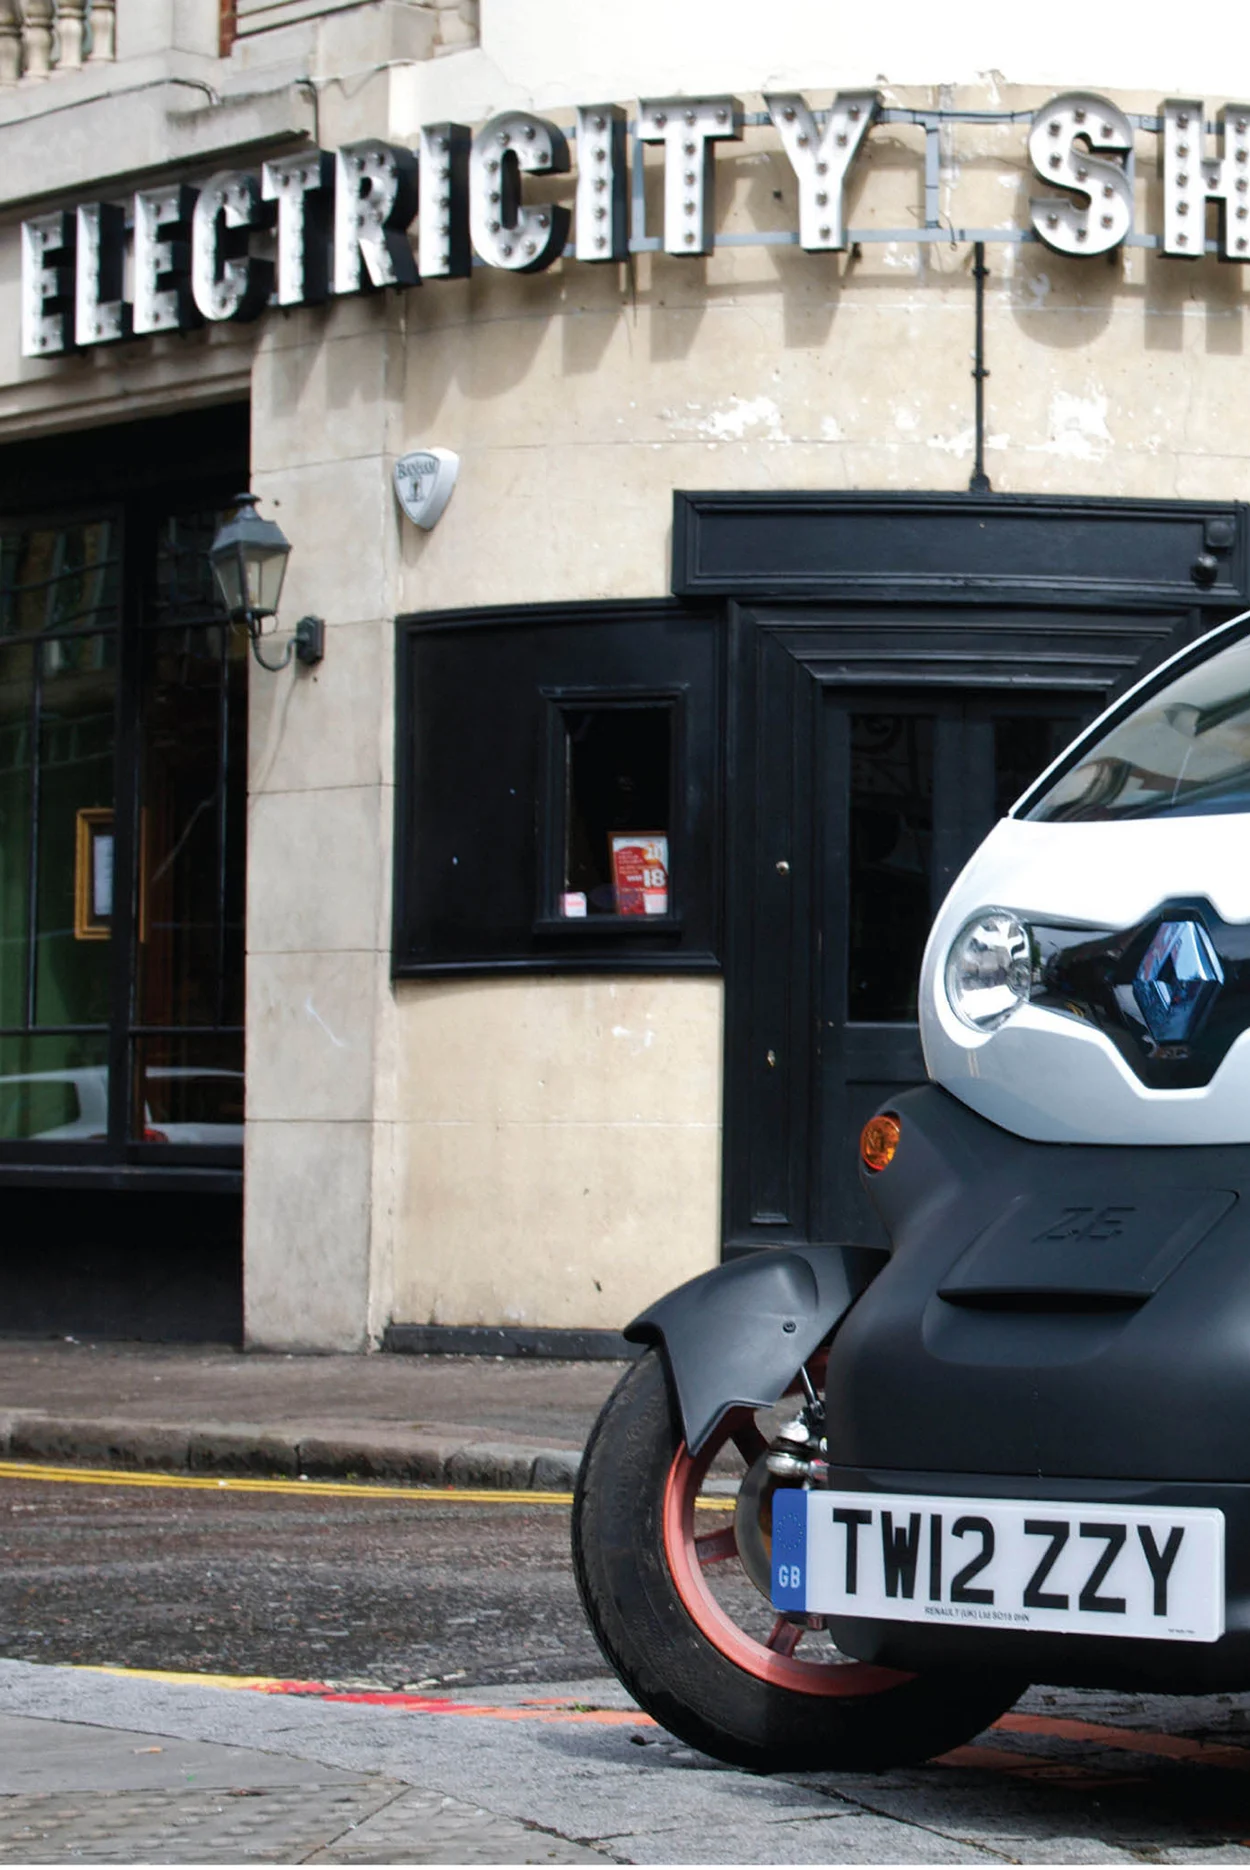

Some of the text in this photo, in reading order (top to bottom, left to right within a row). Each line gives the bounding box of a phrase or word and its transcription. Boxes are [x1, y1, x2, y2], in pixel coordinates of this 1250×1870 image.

[20, 91, 883, 359] ELECTRICITY
[778, 1565, 801, 1588] GB
[832, 1507, 1186, 1617] TW12 ZZY
